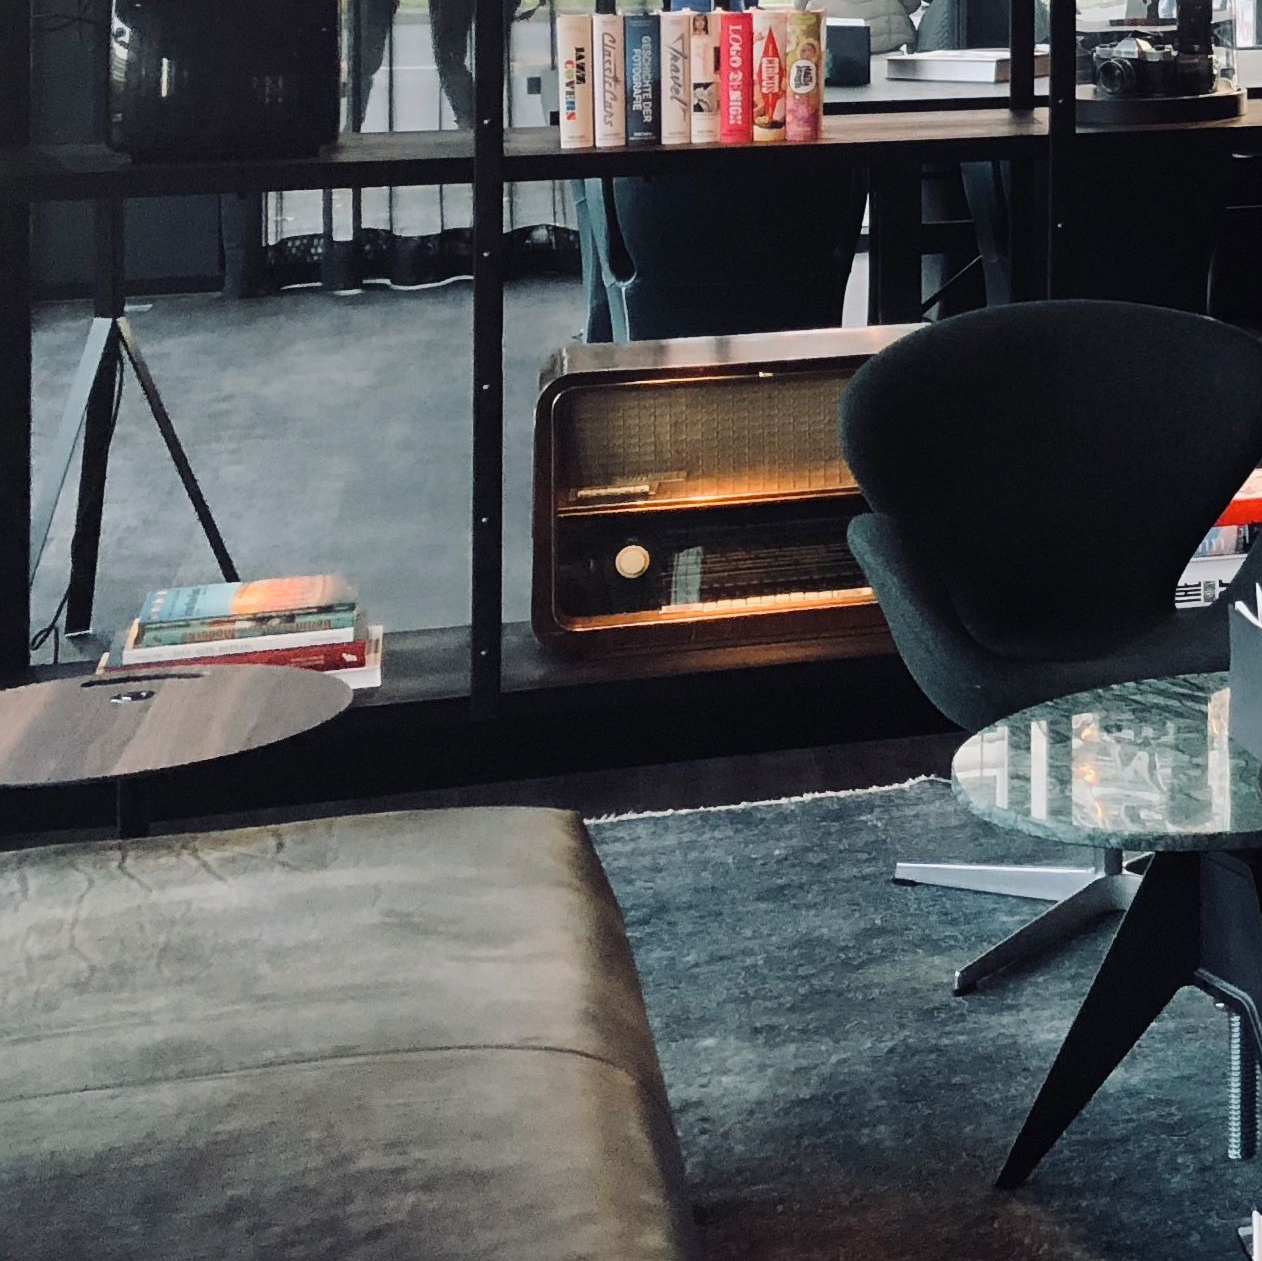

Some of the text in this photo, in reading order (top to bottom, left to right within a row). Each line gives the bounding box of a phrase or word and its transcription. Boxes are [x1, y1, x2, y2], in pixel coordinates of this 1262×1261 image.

[565, 59, 576, 121] COVERS
[575, 46, 586, 85] JAZZ
[632, 48, 642, 111] FOTOGRAFIE
[641, 35, 653, 123] GESCHICHTE DER
[664, 33, 688, 122] Travel
[728, 24, 743, 126] LOGO DESIGN
[762, 57, 779, 94] CIRCUS
